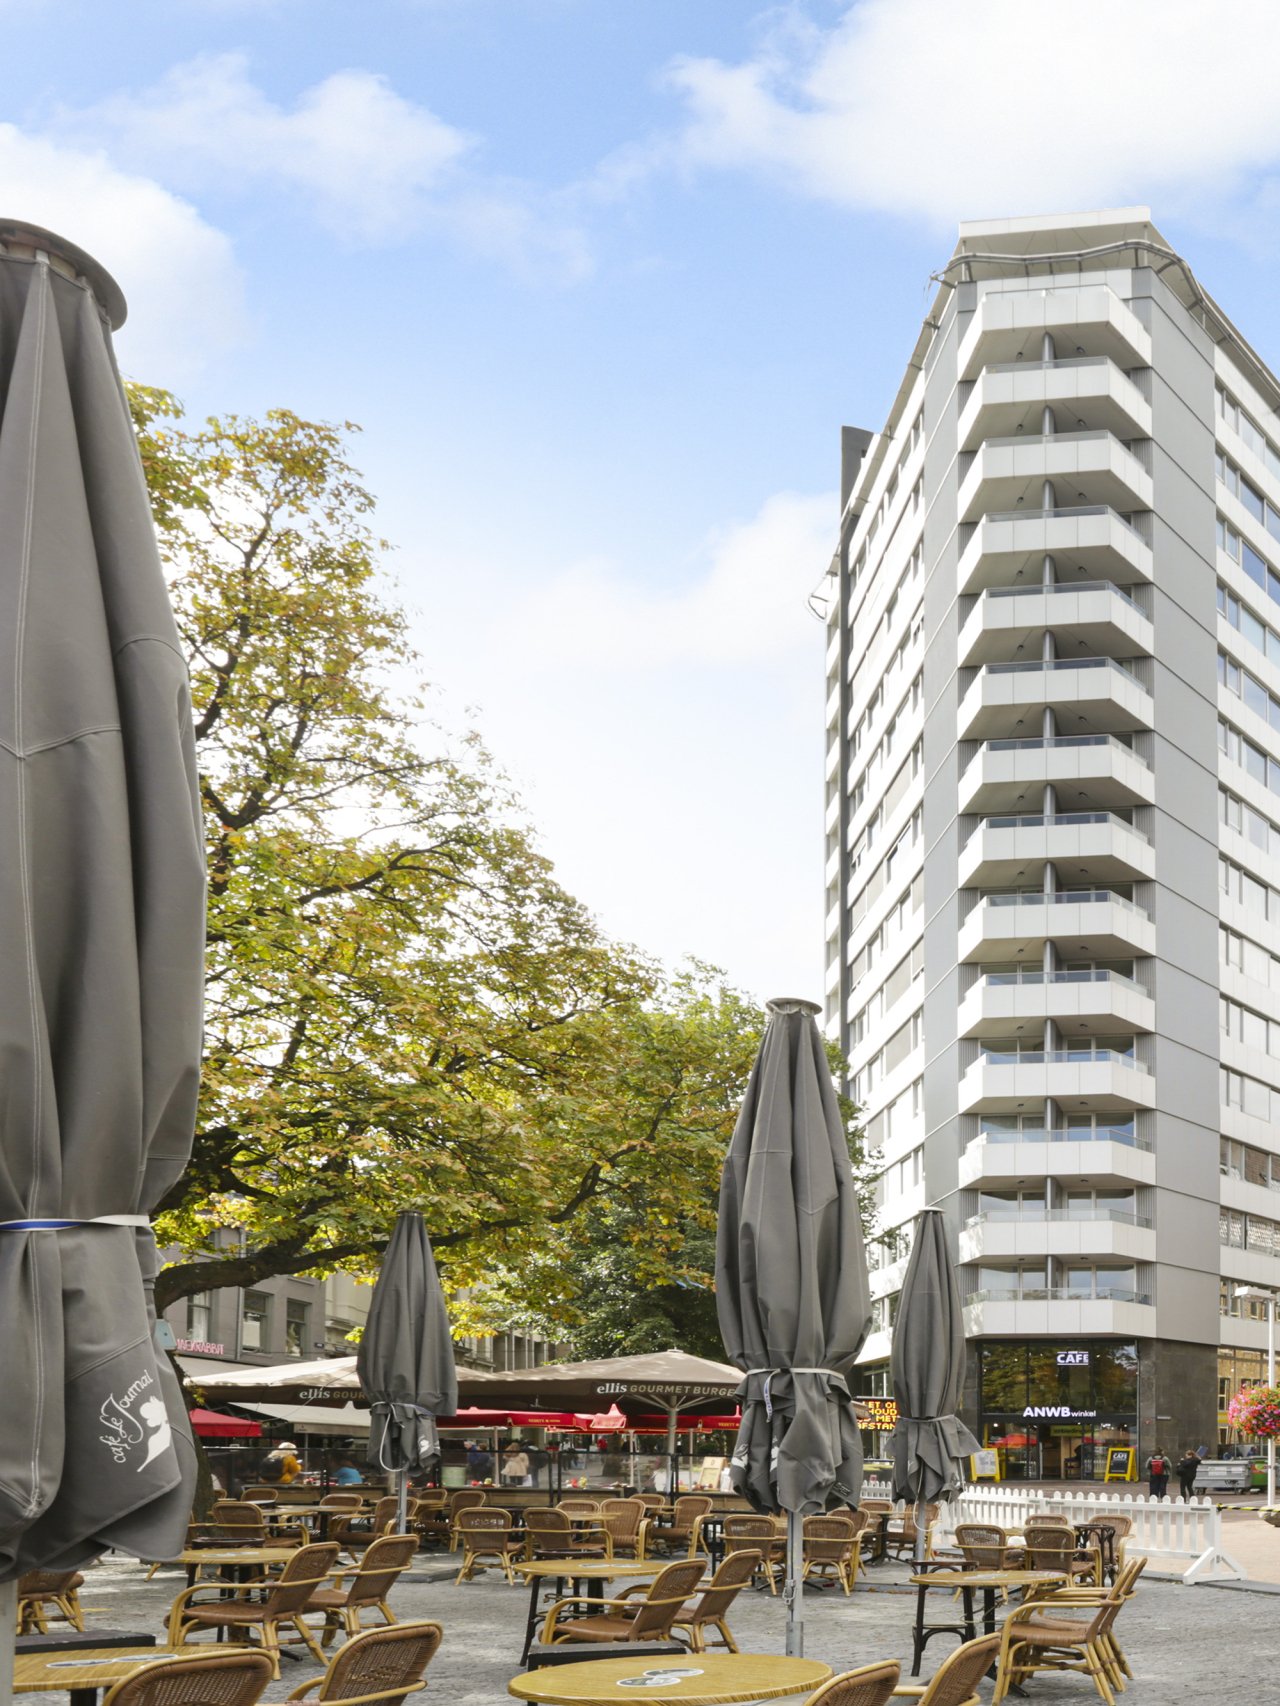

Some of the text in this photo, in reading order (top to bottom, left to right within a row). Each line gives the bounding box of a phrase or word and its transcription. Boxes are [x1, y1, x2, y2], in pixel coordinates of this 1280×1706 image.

[299, 1388, 368, 1399] ellis GOUR
[596, 1382, 627, 1394] ellis
[629, 1384, 691, 1394] GOURMET
[100, 1369, 154, 1444] Journal
[1022, 1406, 1097, 1417] ANWB winkel
